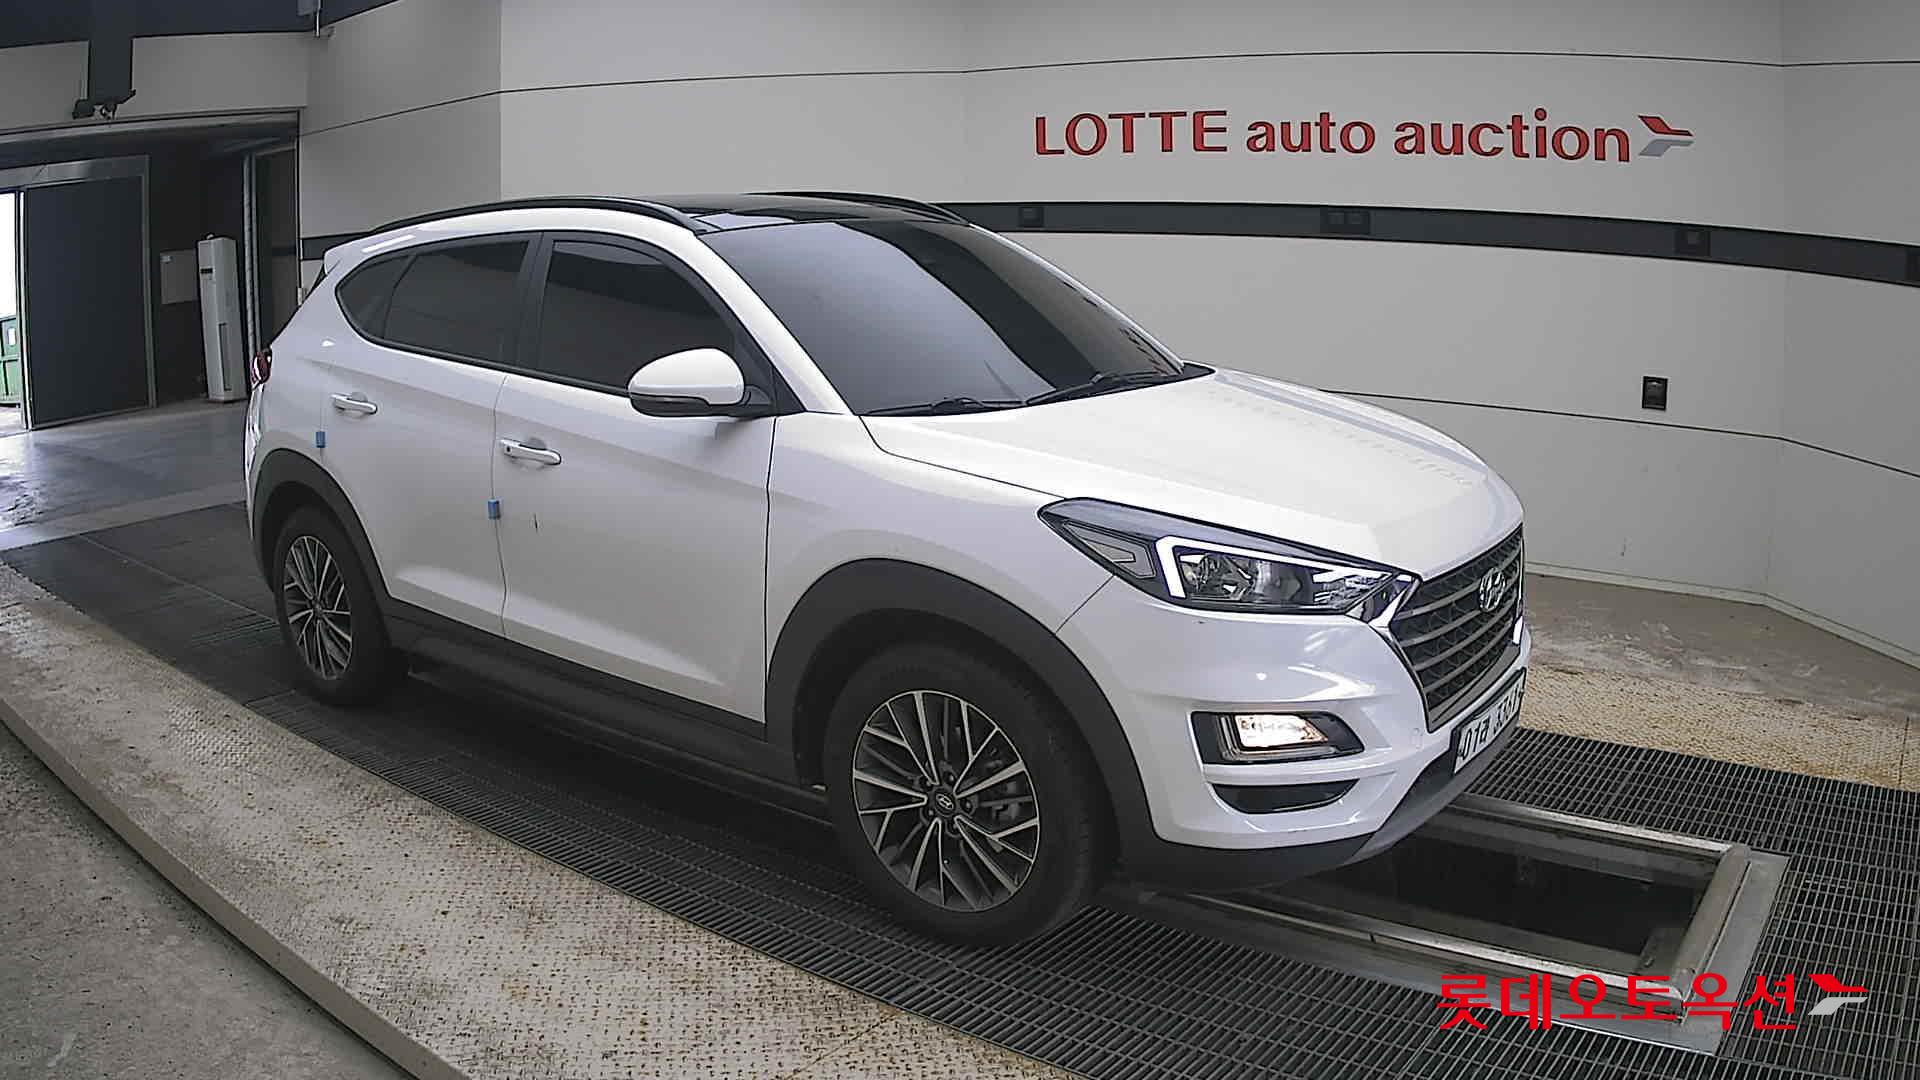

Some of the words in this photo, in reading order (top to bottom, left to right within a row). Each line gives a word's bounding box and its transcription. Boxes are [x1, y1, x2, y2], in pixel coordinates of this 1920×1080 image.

[1035, 110, 1228, 156] LOTTE
[1246, 111, 1376, 154] auto
[1393, 107, 1631, 163] auction
